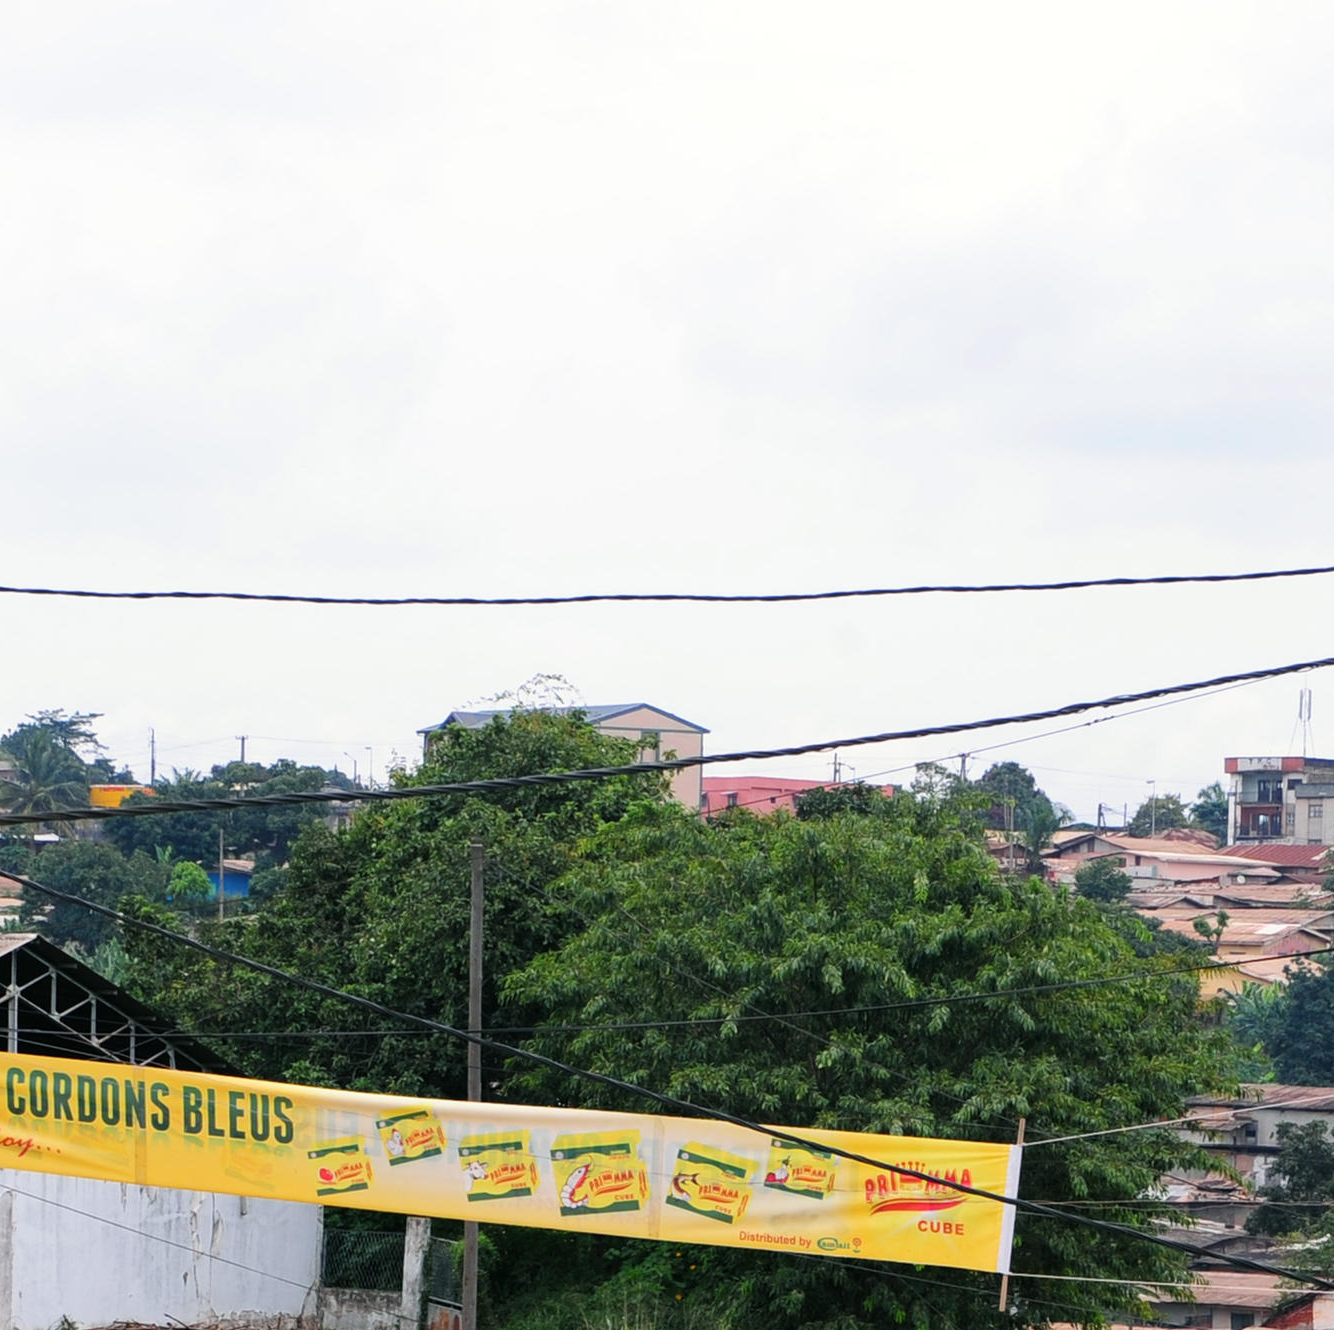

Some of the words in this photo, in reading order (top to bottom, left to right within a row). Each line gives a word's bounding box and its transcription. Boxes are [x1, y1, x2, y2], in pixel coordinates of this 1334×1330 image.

[6, 1066, 170, 1131] CORDONS
[183, 1083, 295, 1144] BLEUS
[917, 1221, 964, 1236] CUBE
[739, 1231, 796, 1245] Distributed
[799, 1236, 812, 1249] by
